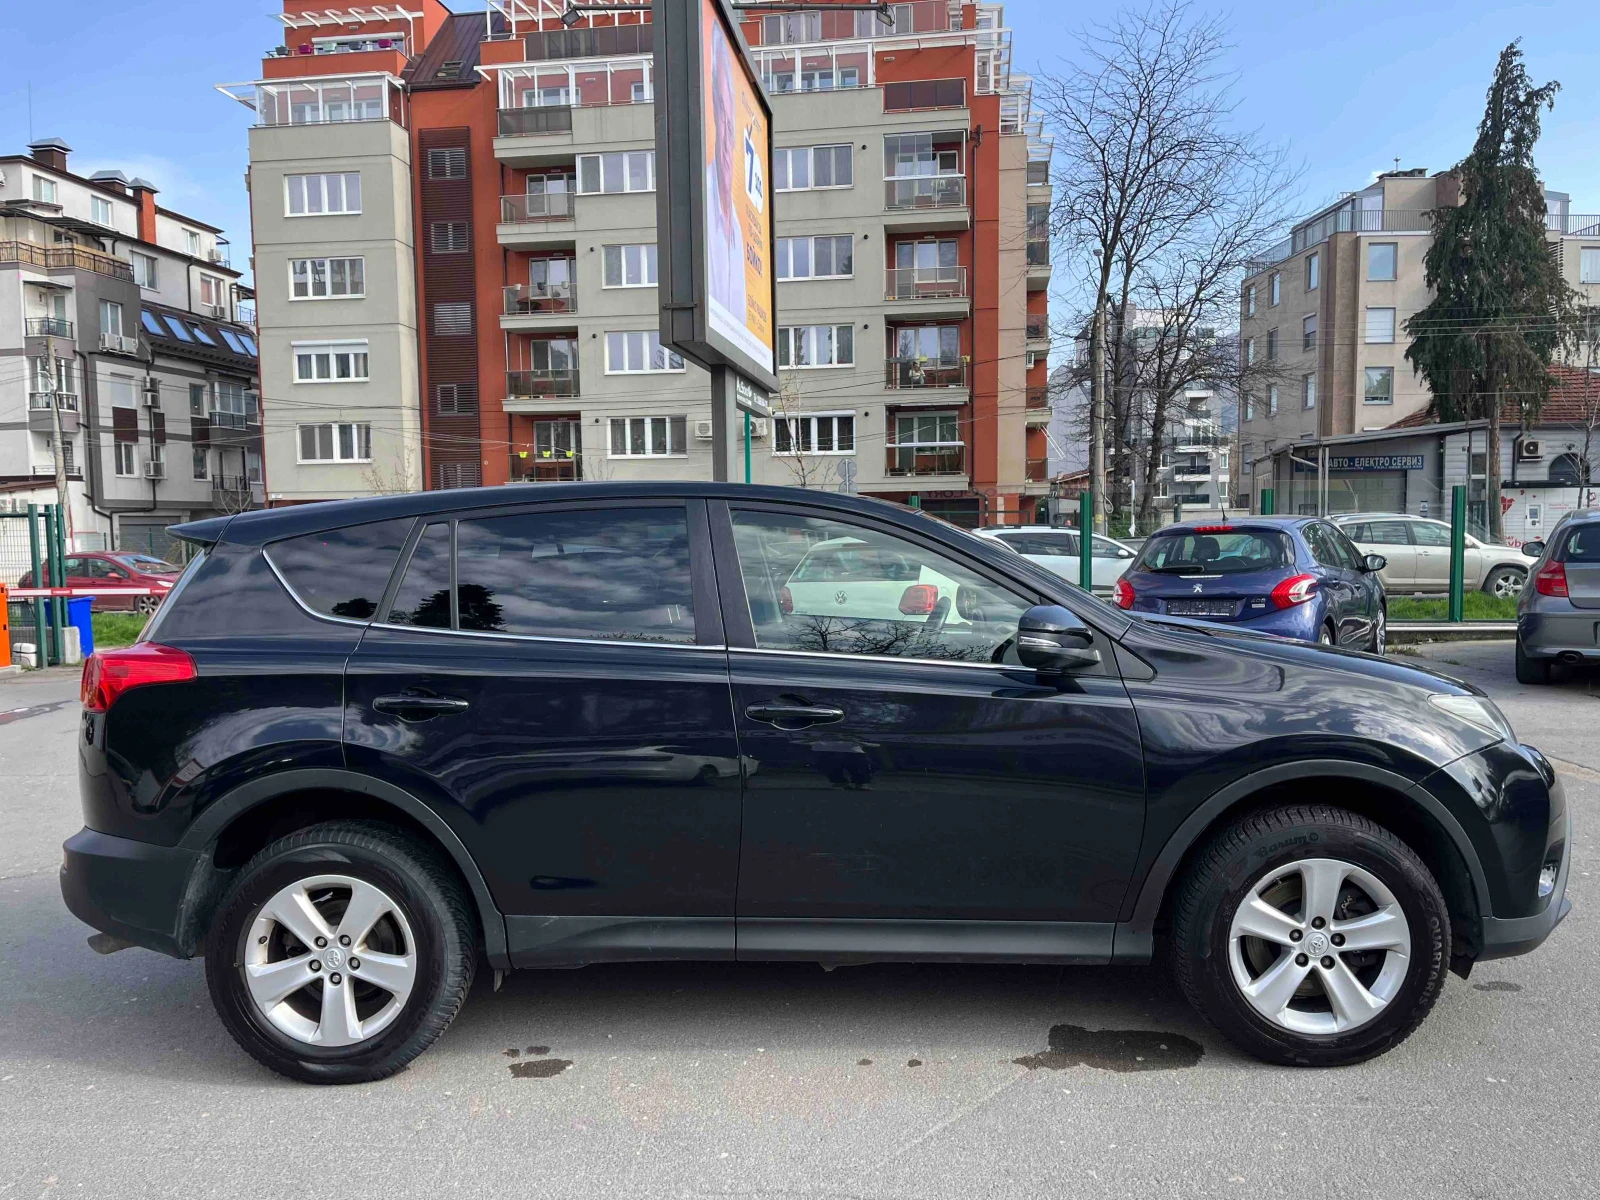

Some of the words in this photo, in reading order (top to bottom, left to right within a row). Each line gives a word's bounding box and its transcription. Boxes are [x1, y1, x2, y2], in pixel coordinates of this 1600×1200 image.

[745, 137, 754, 194] 7
[1328, 458, 1349, 468] АВТО
[1354, 457, 1390, 467] ЕЛЕКТРО
[1391, 456, 1422, 466] СЕРВИЗ
[1253, 835, 1308, 858] Barum
[1416, 916, 1443, 1007] QUARTARIS
